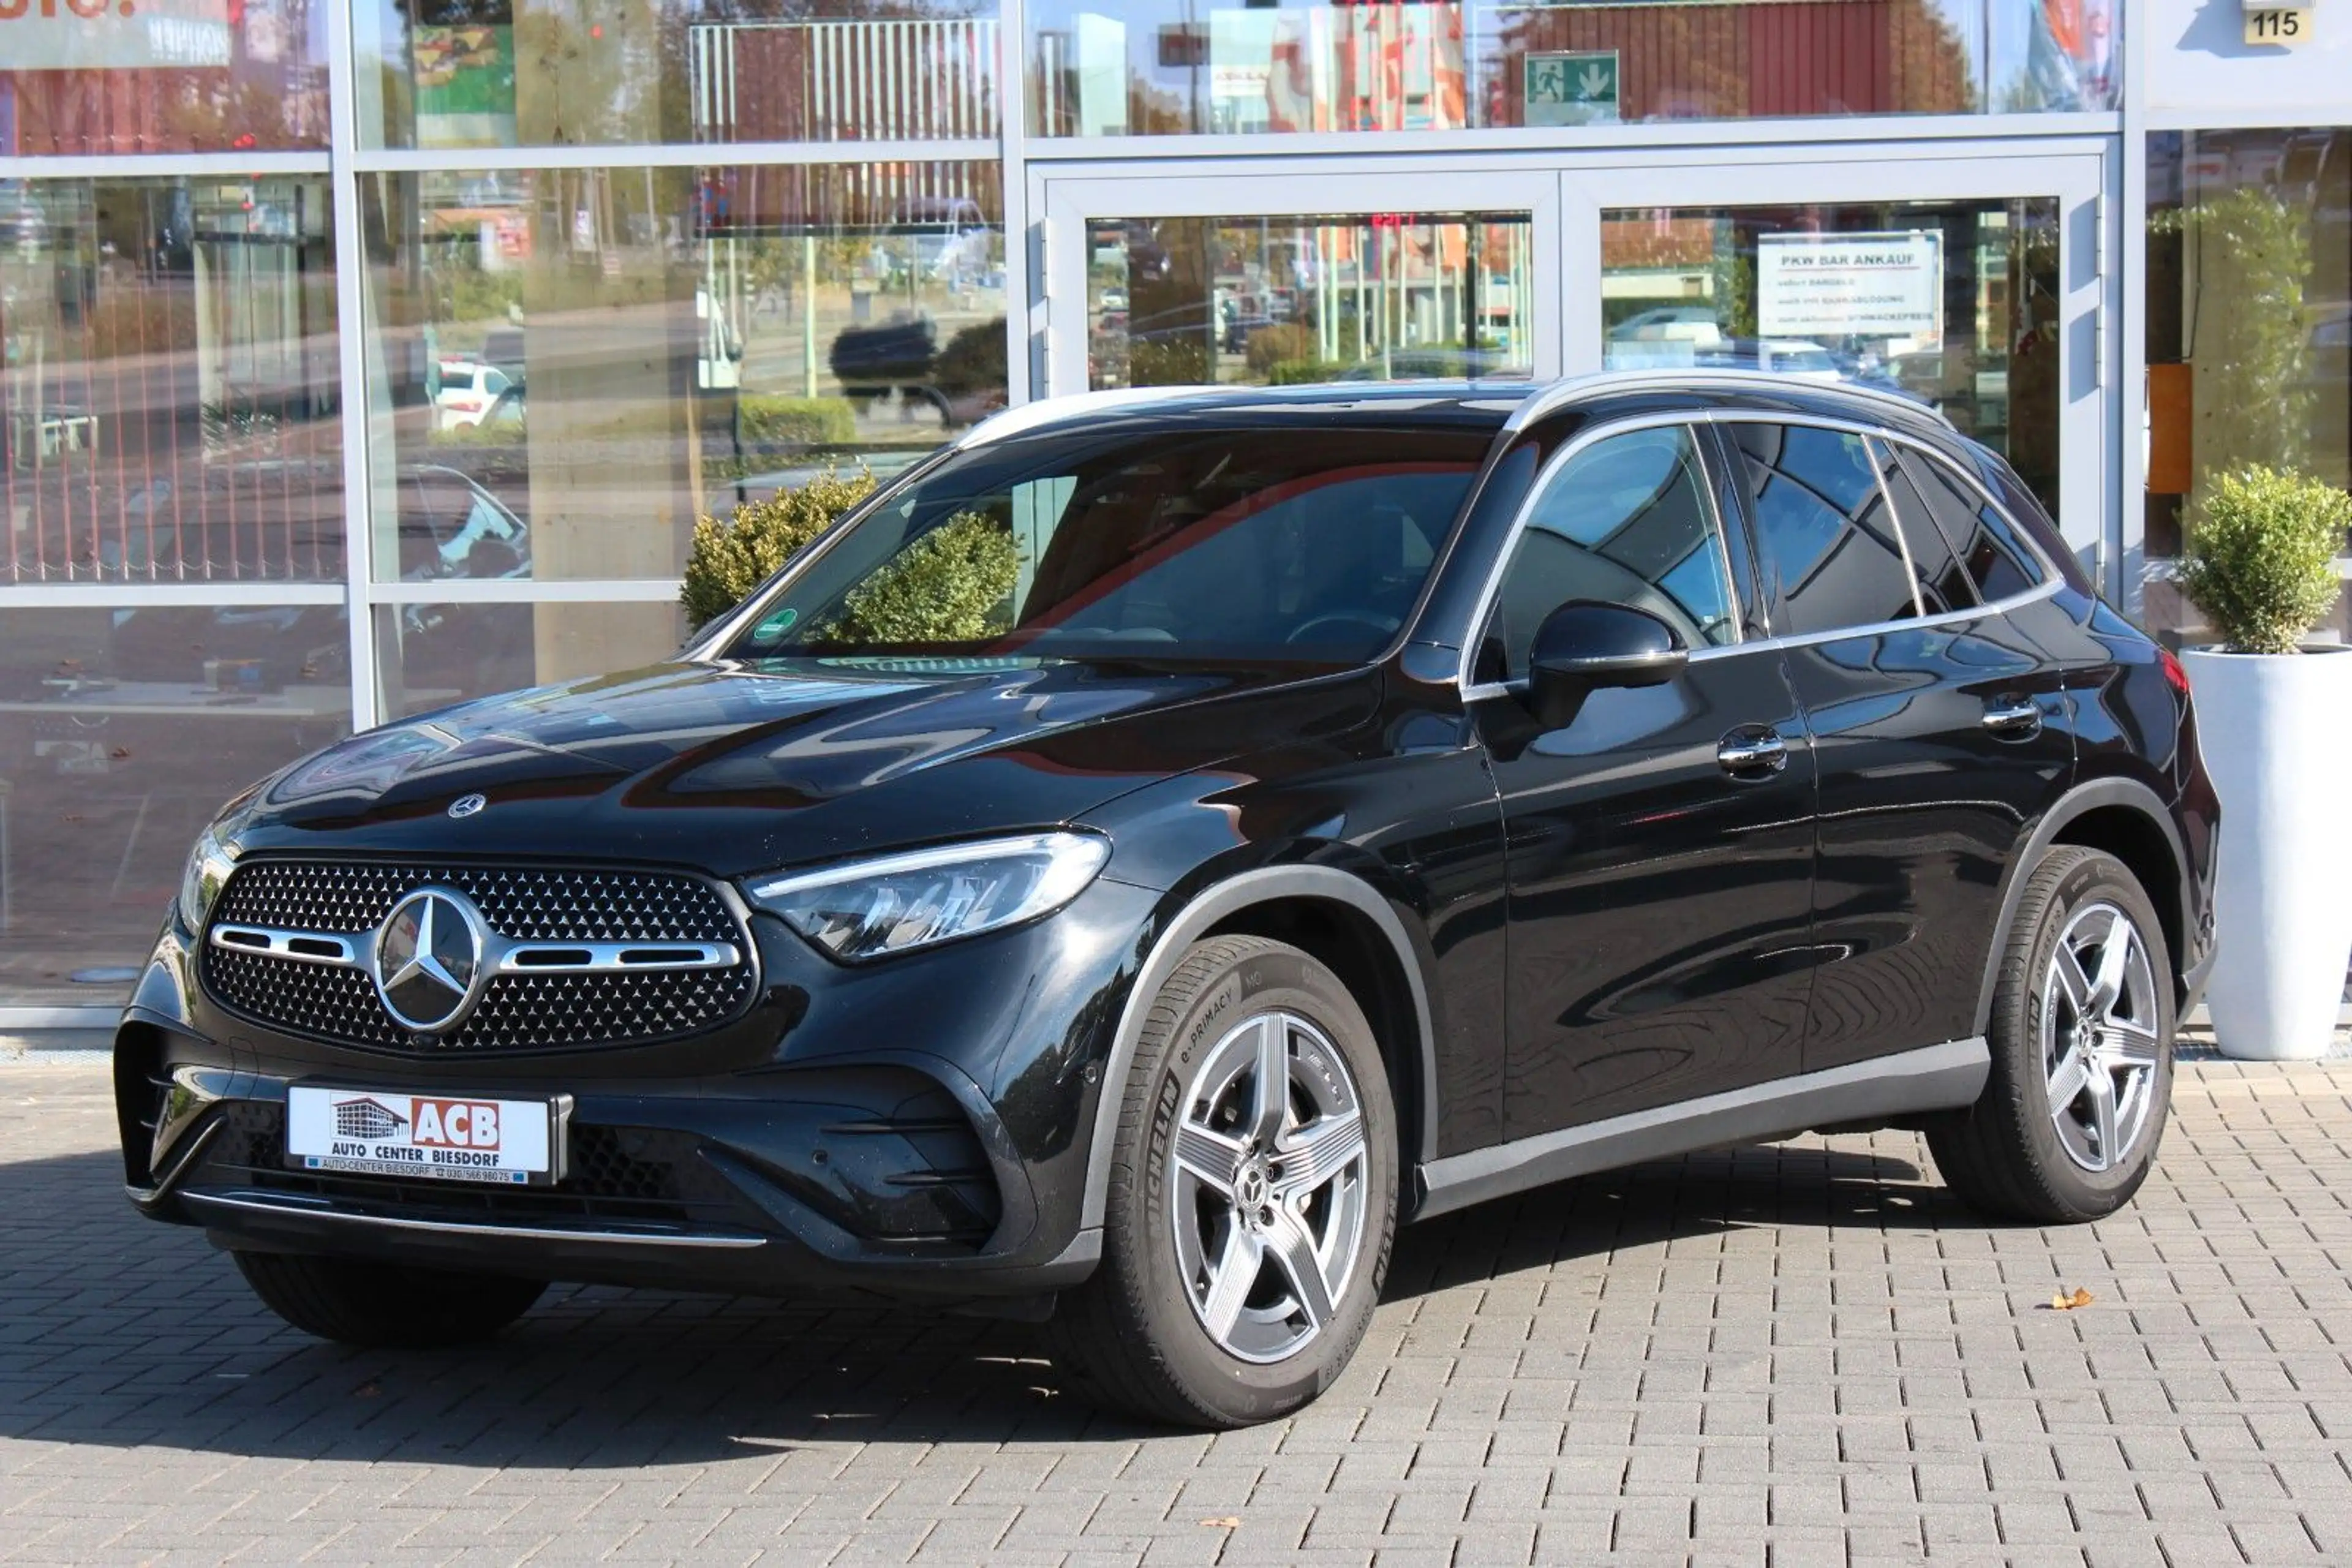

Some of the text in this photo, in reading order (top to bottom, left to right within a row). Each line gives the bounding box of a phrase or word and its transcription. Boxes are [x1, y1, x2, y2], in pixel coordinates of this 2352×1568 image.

[2253, 11, 2299, 37] 115
[1781, 253, 1915, 266] PKW BAR ANKAUF
[414, 1102, 499, 1147] ACB
[331, 1142, 500, 1167] AUTO CENTER BIESDORF
[1148, 1076, 1178, 1237] MICHELIN
[385, 1163, 430, 1175] BIESDORF
